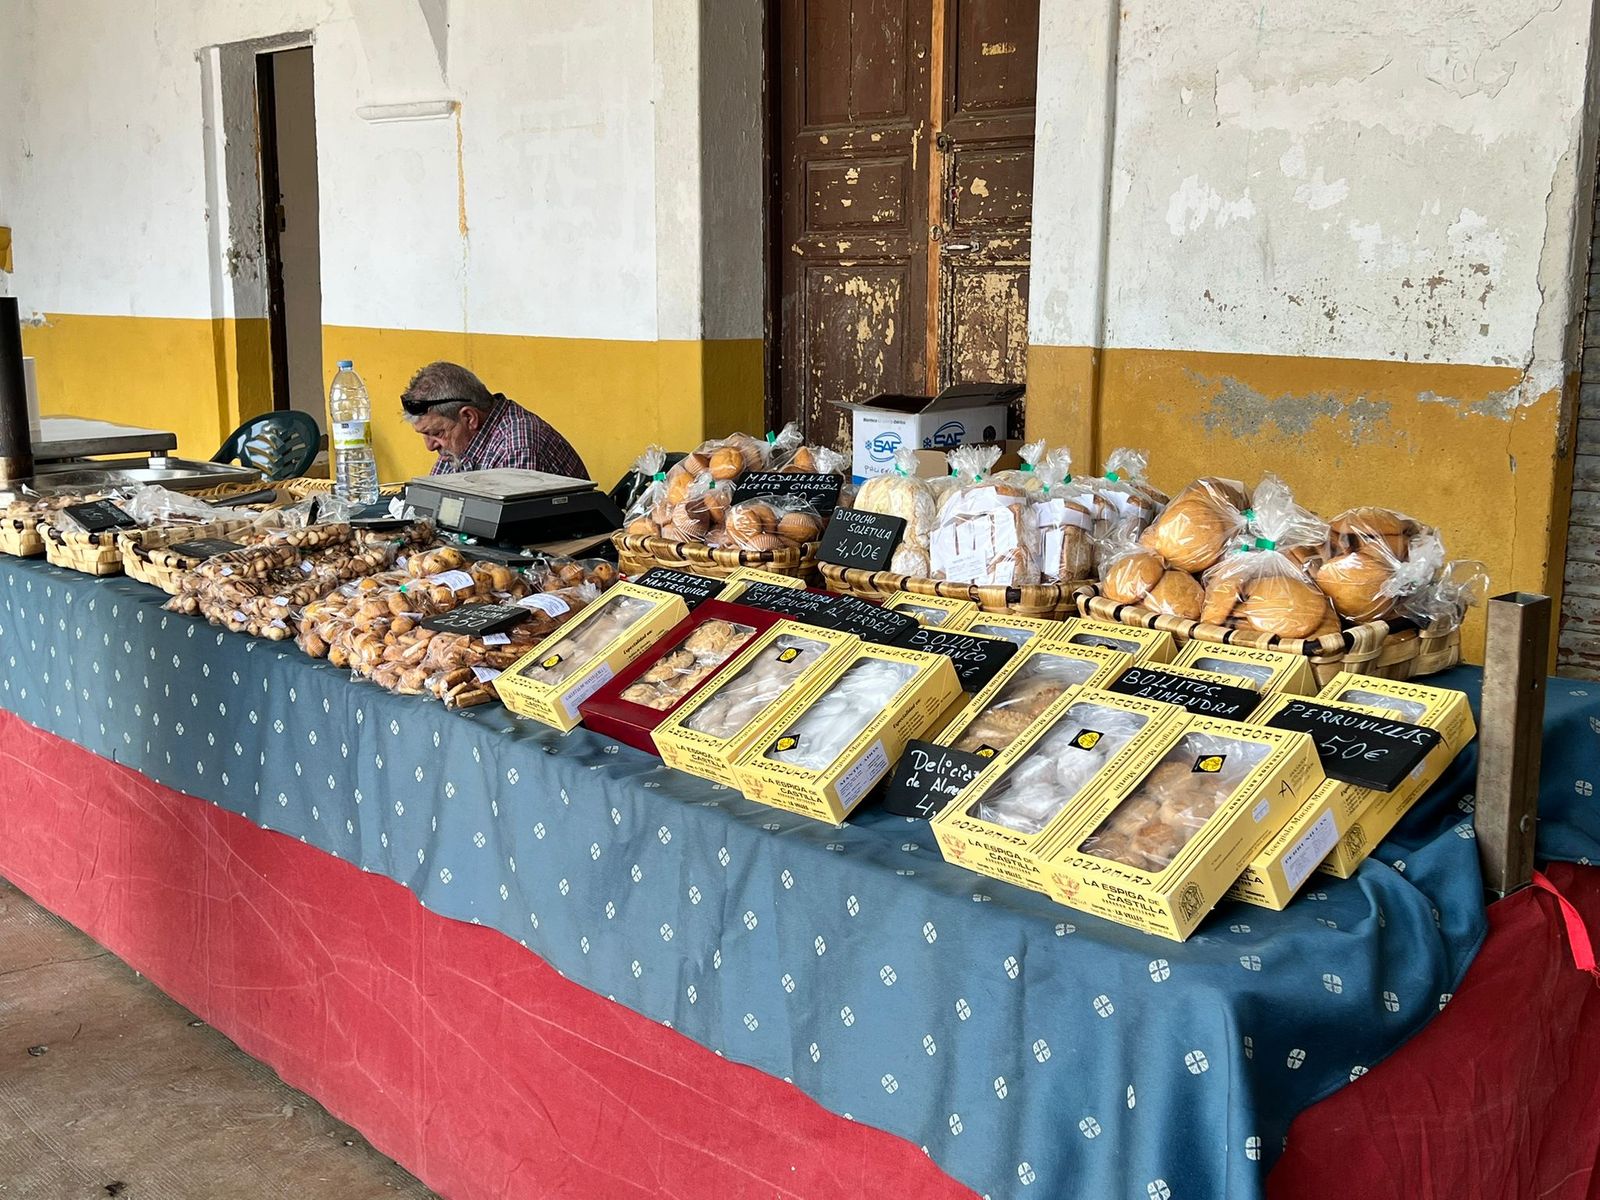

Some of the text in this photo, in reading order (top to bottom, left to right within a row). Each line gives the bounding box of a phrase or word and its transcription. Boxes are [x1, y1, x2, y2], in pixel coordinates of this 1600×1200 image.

[873, 439, 902, 453] SAF
[934, 432, 966, 448] SAF
[789, 483, 838, 491] GIRASOL
[836, 509, 877, 525] BIZCOCHO
[847, 523, 893, 540] SOLETILLA
[836, 538, 881, 561] 4,00€
[641, 577, 710, 597] MANTEQUILLA
[749, 582, 785, 593] PASTA
[746, 591, 776, 602] SIN
[838, 596, 908, 627] MANTECADO
[824, 607, 843, 618] AL
[845, 611, 896, 635] VERDEJO
[976, 615, 1043, 629] PRODUCTOS
[1081, 622, 1150, 638] ARTESANOS
[865, 645, 930, 662] ARTESANOS
[1039, 642, 1109, 660] PRODUCTOS
[1203, 645, 1284, 663] ARTESANOS
[1351, 679, 1438, 701] PRODUCTOS
[1081, 691, 1161, 713] PRODUCTOS
[1134, 686, 1240, 715] ALMENDRA
[1193, 720, 1284, 742] PRODUCTOS
[906, 772, 920, 788] de
[951, 820, 1028, 847] ARTESANOS
[983, 843, 1022, 860] ESPIGA
[989, 852, 1041, 874] CASTILLA
[1064, 856, 1152, 886] ARTESANOS
[1083, 877, 1100, 889] LA
[1101, 883, 1147, 902] ESPIGA
[1107, 893, 1168, 916] CASTILLA
